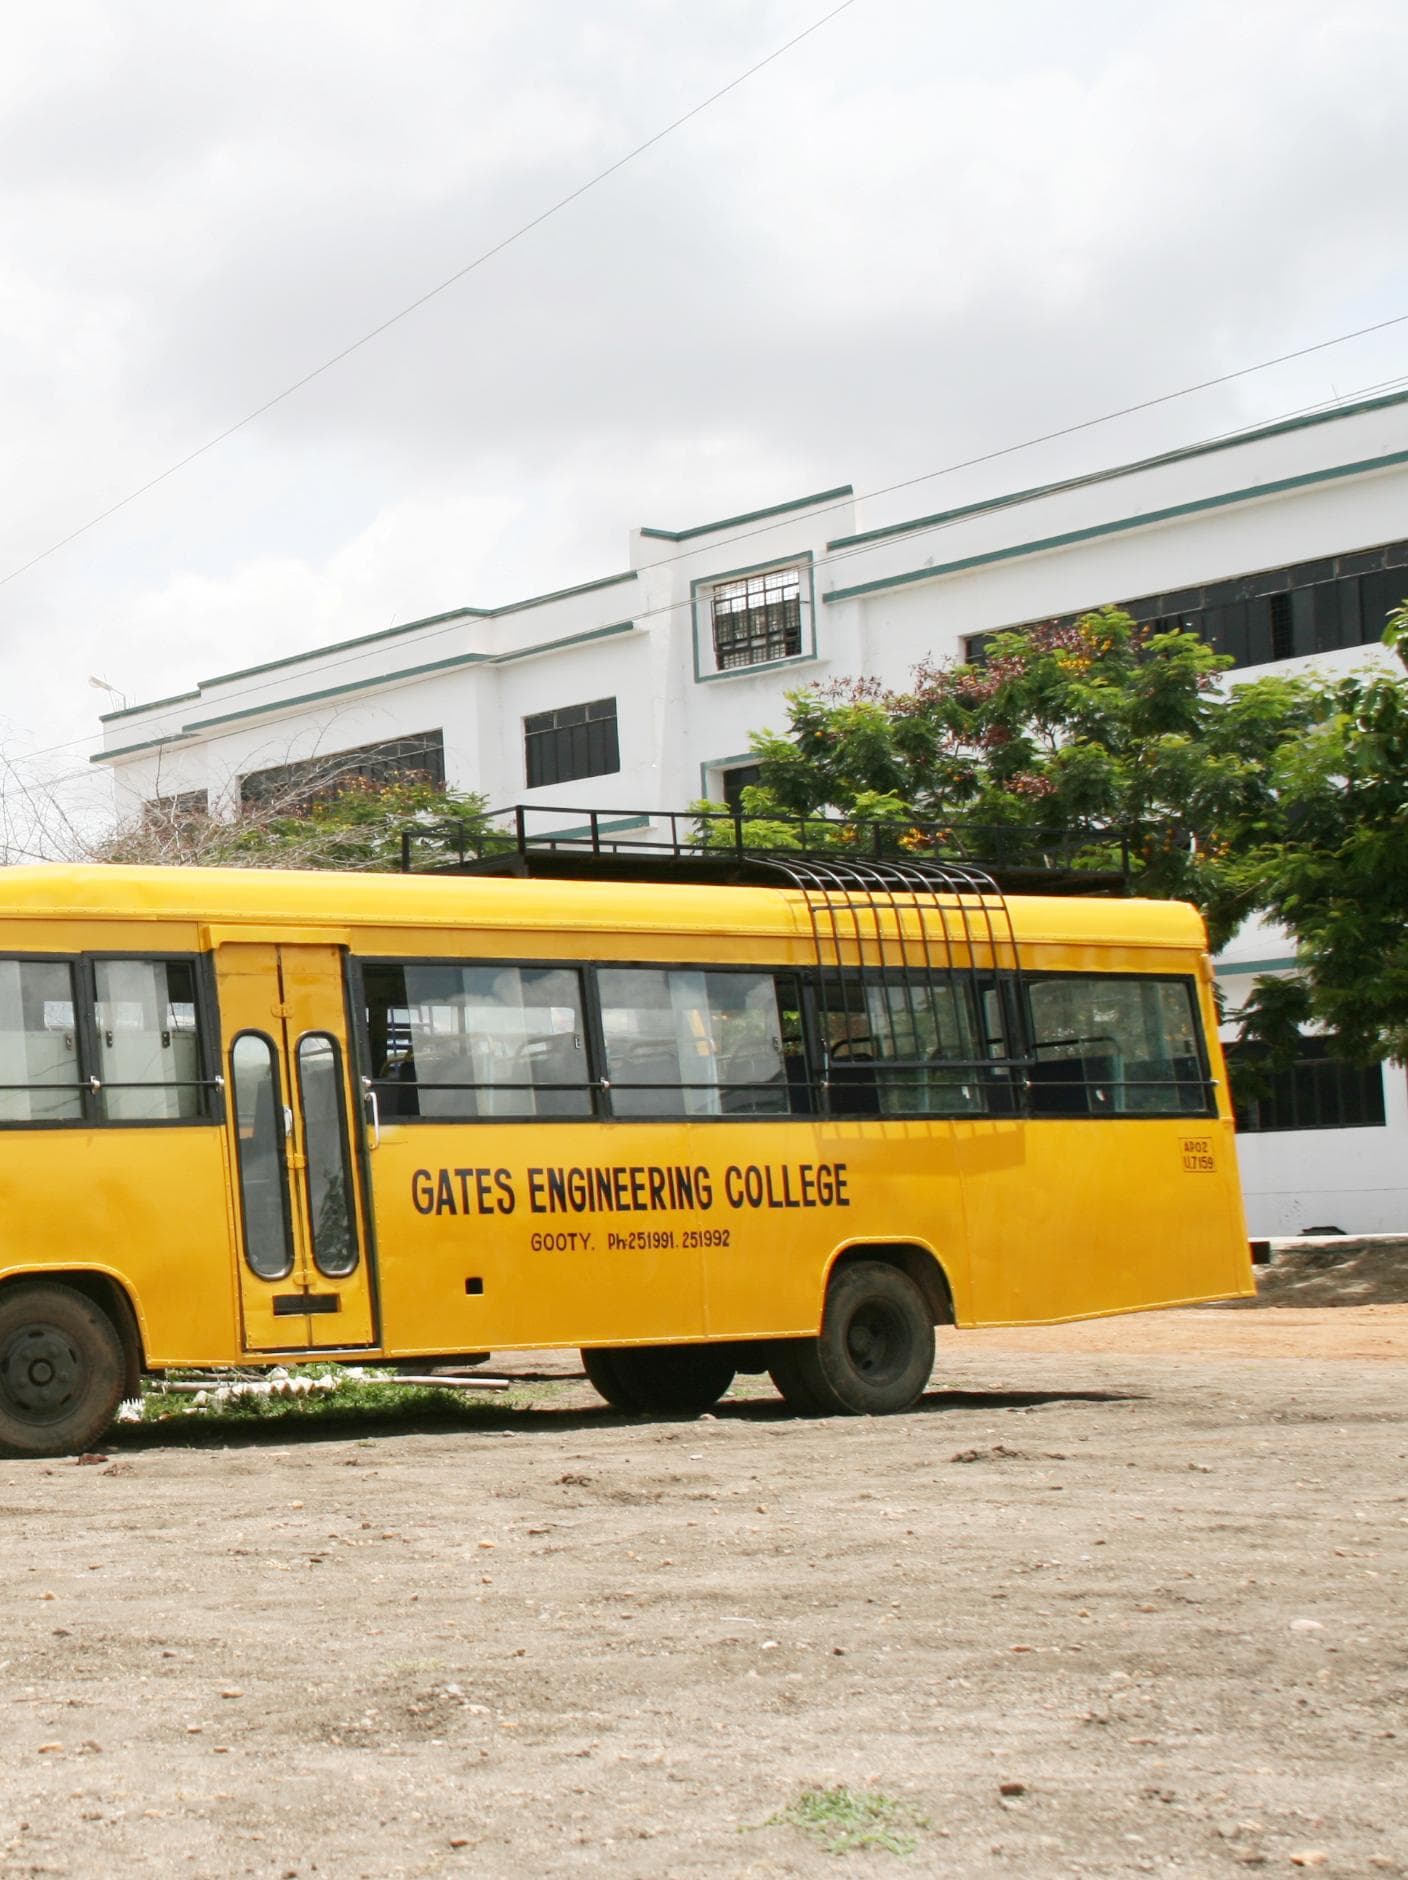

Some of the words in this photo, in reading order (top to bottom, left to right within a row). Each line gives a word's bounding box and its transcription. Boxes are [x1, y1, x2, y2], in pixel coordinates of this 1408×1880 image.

[411, 1168, 516, 1216] GATES
[527, 1166, 713, 1214] ENGINEERING
[724, 1163, 850, 1209] COLLEGE
